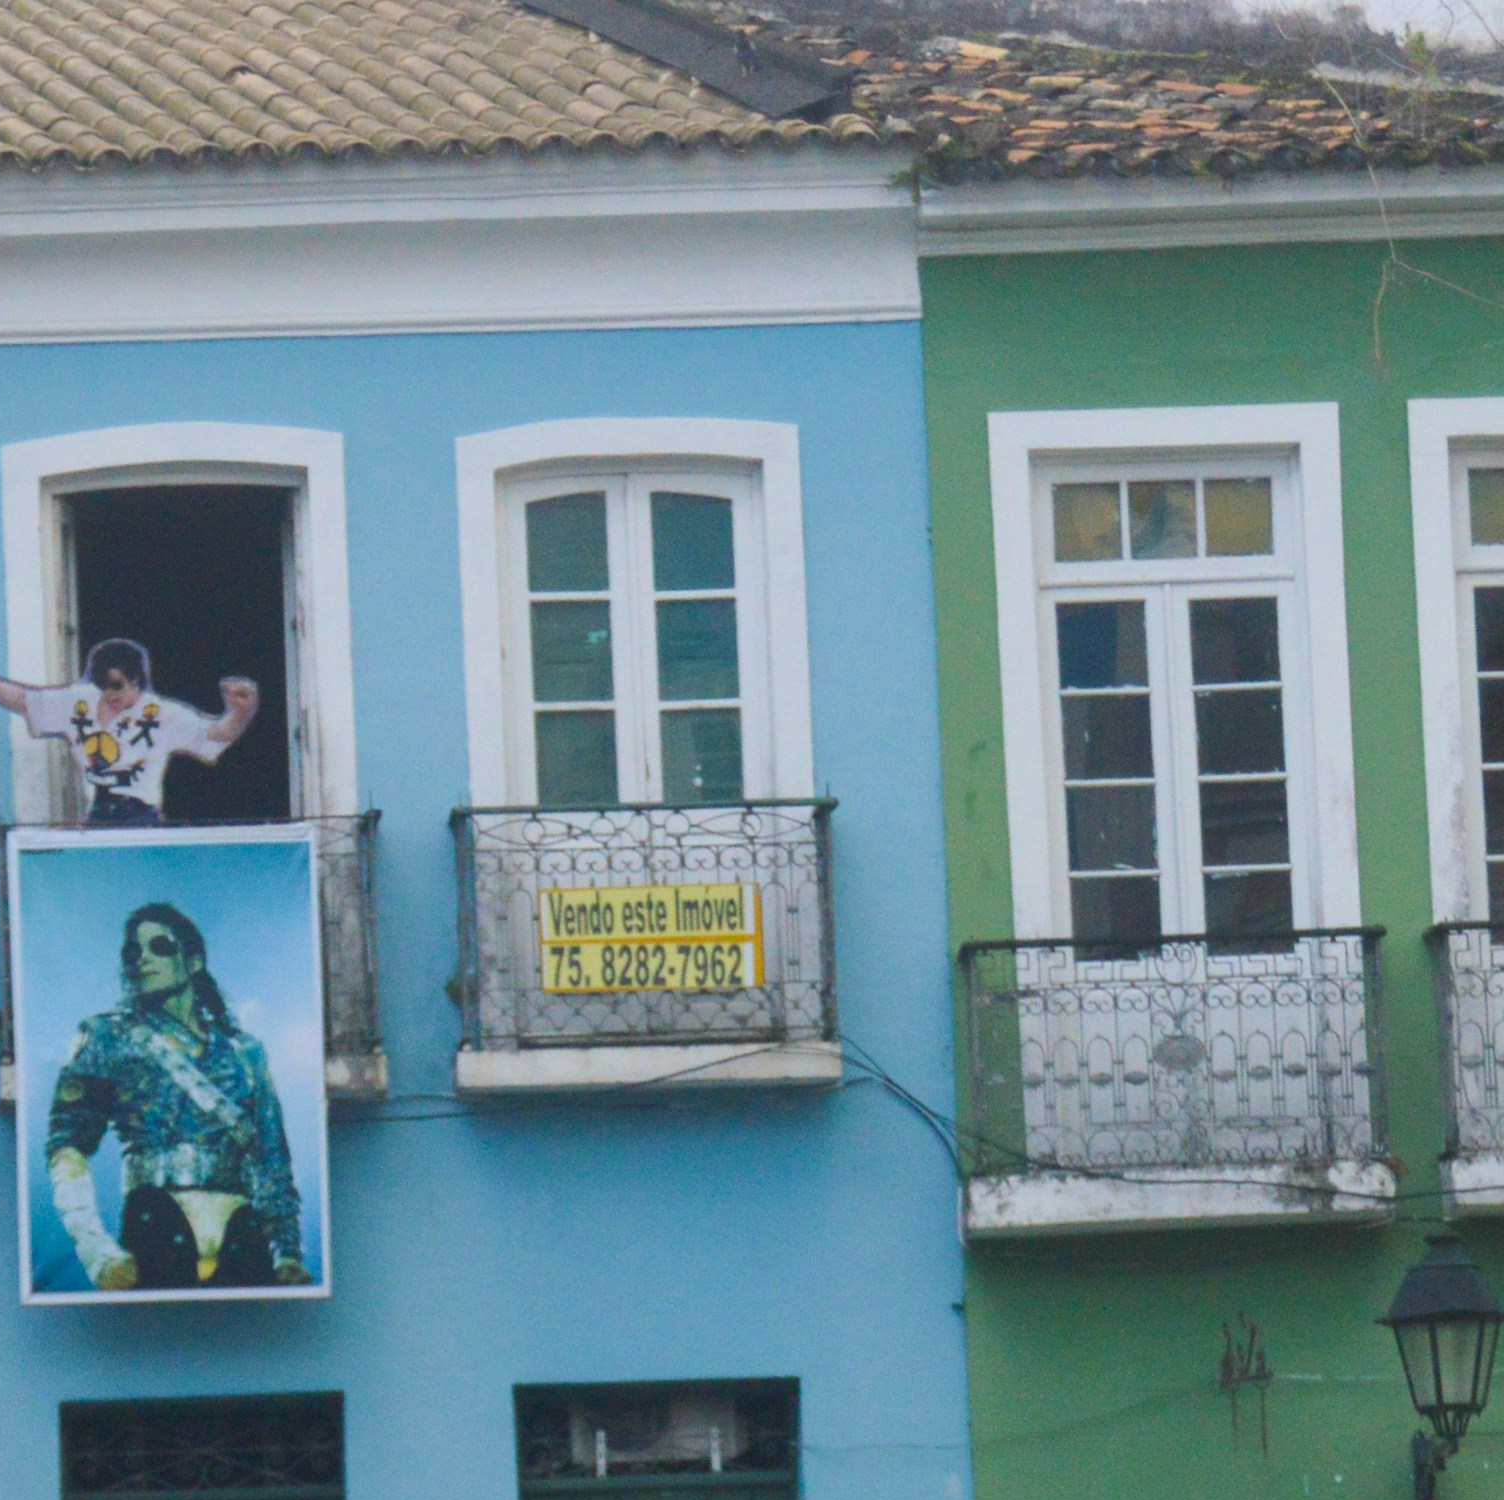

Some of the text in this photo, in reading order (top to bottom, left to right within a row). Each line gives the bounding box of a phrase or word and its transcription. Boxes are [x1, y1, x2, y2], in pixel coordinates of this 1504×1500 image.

[549, 886, 744, 936] Vendo este Imóvel
[601, 944, 742, 986] 8282-7962
